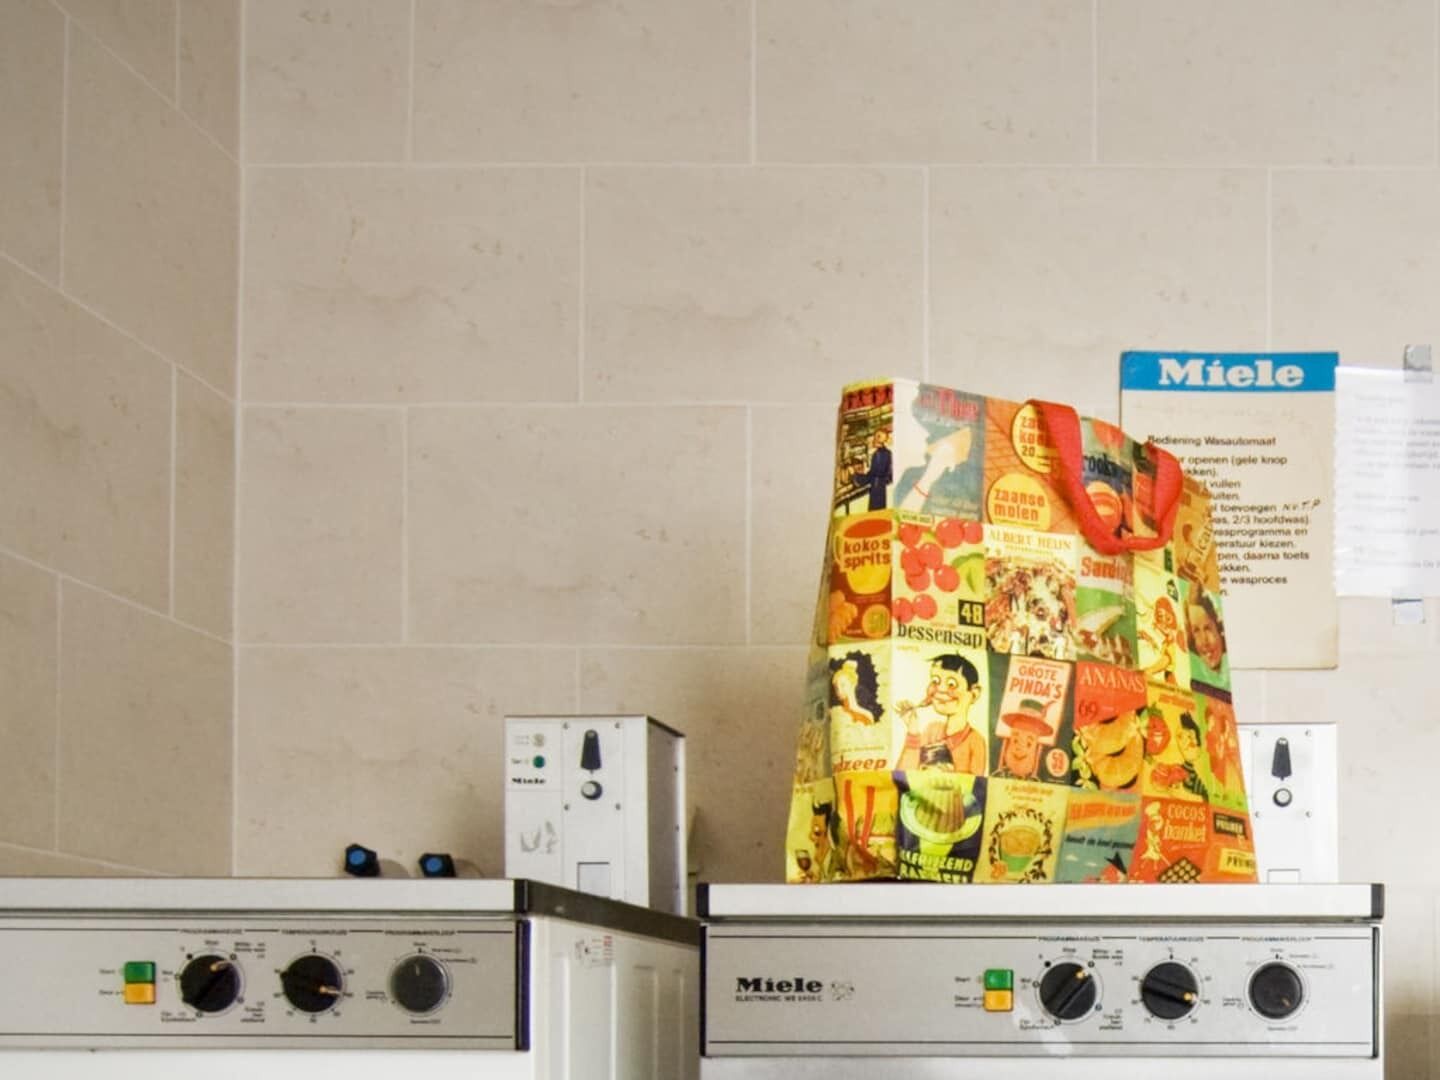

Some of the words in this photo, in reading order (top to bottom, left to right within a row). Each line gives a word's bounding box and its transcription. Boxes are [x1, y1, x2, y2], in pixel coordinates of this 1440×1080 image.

[1158, 358, 1305, 387] Miele
[1148, 435, 1201, 447] Bediening
[1204, 436, 1276, 446] Wasautomaat
[1188, 456, 1228, 466] openen
[1231, 456, 1258, 467] (gele
[1261, 456, 1287, 466] knop
[994, 488, 1045, 507] zaanse
[994, 504, 1039, 521] molen
[1220, 503, 1277, 513] toevoegen
[1232, 515, 1251, 525] 2/3
[1294, 528, 1308, 536] en
[843, 539, 891, 554] kokos
[844, 553, 891, 570] sprits
[1283, 552, 1310, 560] toets
[1230, 576, 1288, 586] wasproces
[961, 604, 983, 623] 48
[897, 623, 983, 649] bessensap
[1018, 664, 1057, 681] GROTE
[1080, 666, 1145, 693] ANANAS
[1009, 677, 1062, 699] PINDA'S
[1167, 803, 1206, 821] COCOS
[1163, 821, 1206, 843] banket
[736, 976, 824, 994] Miele
